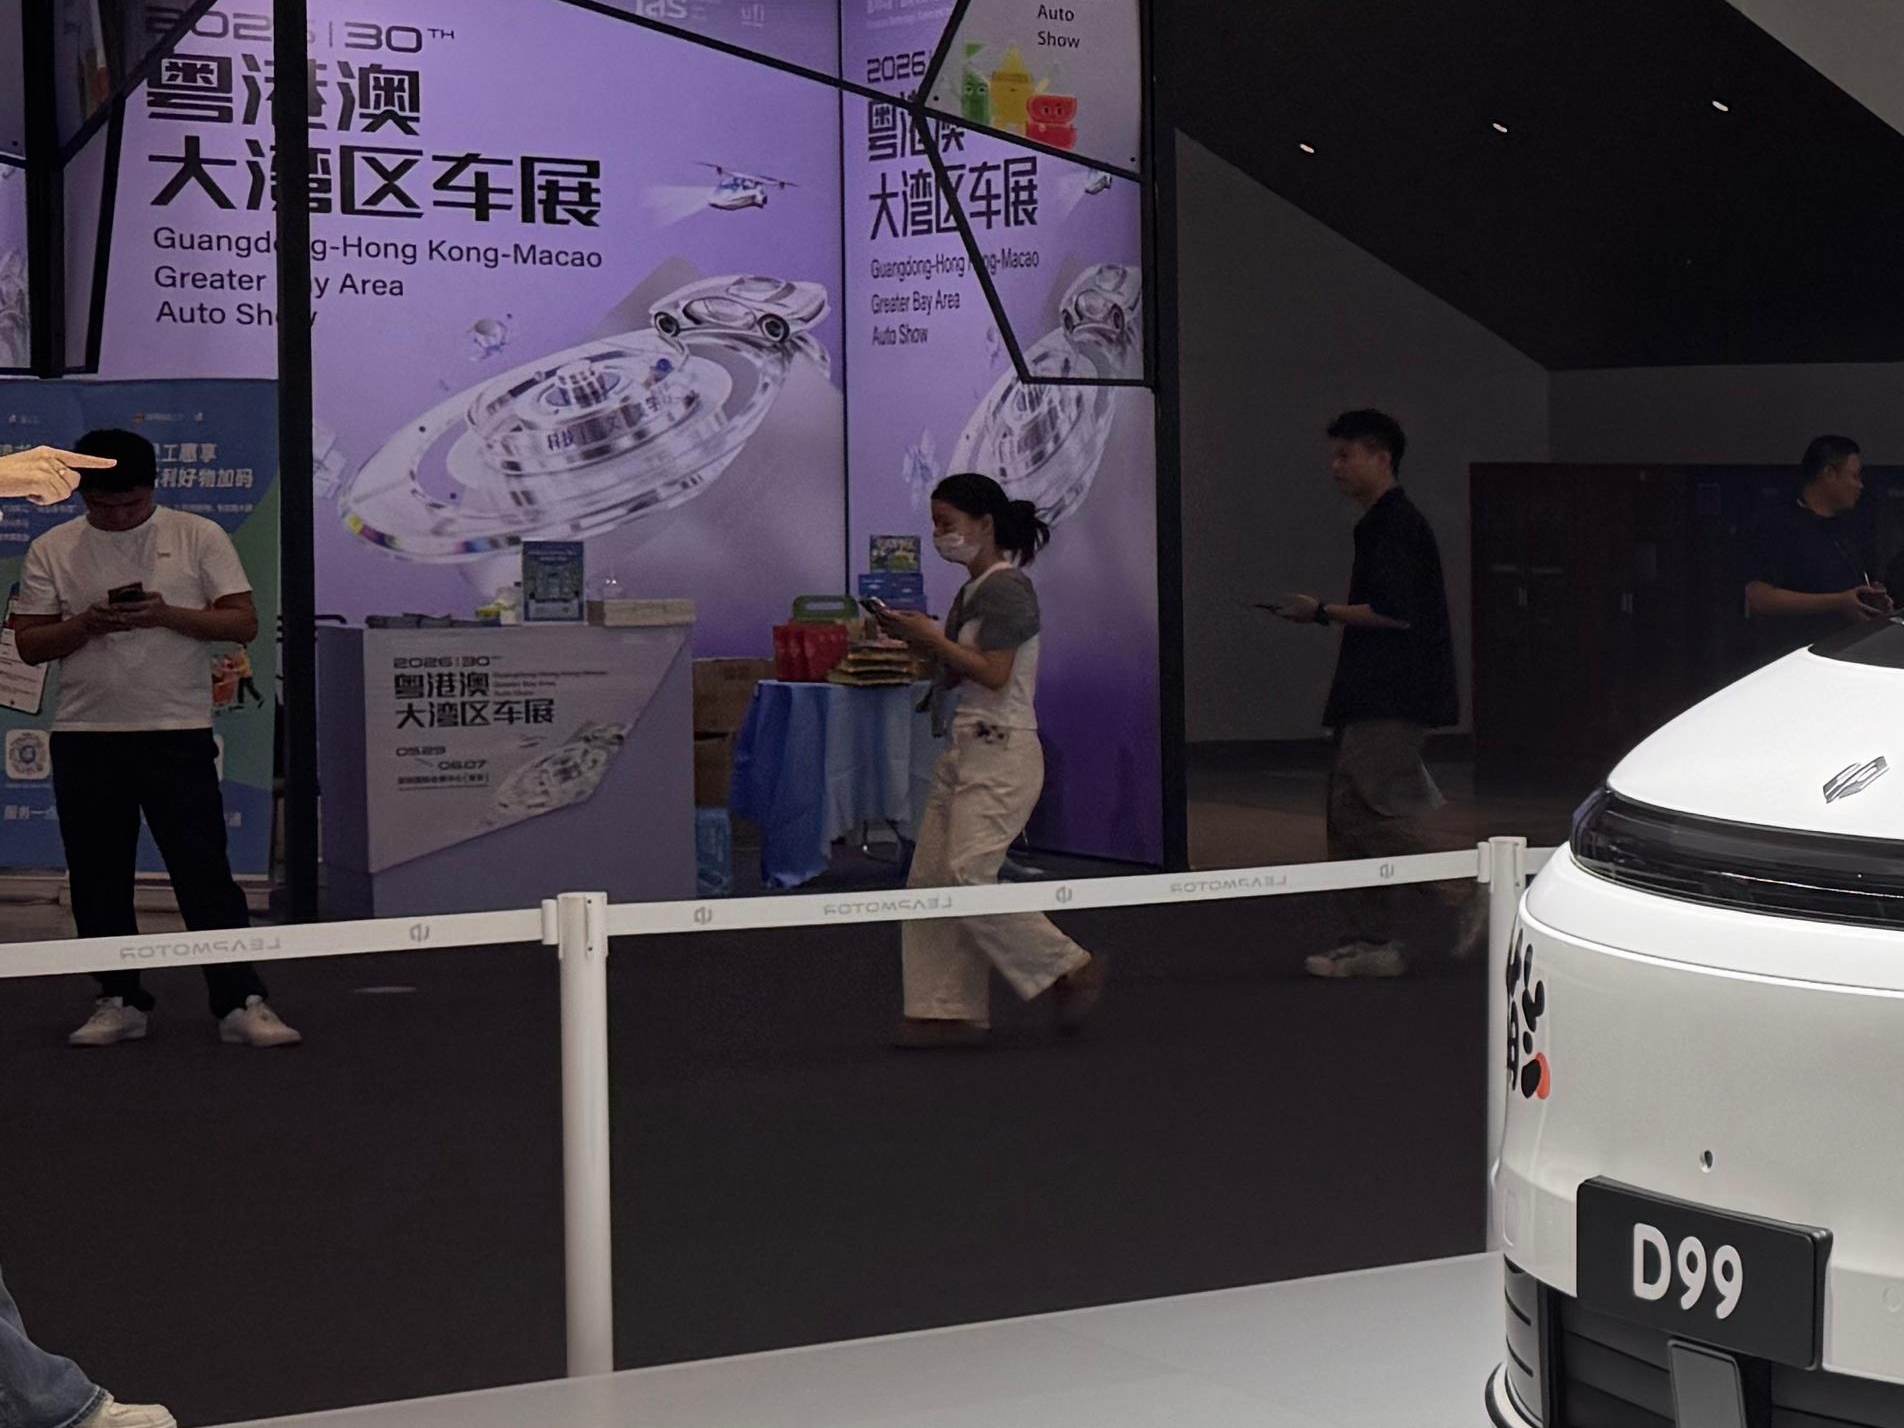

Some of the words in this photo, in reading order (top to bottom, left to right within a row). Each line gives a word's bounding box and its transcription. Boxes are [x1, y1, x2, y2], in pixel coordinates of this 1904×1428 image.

[147, 6, 316, 42] 202
[1037, 4, 1075, 22] Auto
[1037, 30, 1081, 49] Show
[867, 51, 926, 84] 2026
[148, 135, 601, 227] 大湾区车展
[869, 156, 1038, 240] 大湾区车展
[154, 228, 418, 265] Guangdg-Hong
[429, 240, 603, 269] Kong-Macao
[154, 266, 266, 292] Greater
[340, 273, 404, 296] Area
[155, 300, 226, 326] Auto
[872, 293, 911, 315] Greater
[913, 292, 933, 314] Bay
[935, 290, 961, 310] Area
[872, 325, 898, 346] Auto
[899, 323, 929, 345] Show
[155, 443, 218, 463] 工惠享
[154, 467, 254, 489] 利好物加码
[394, 672, 489, 699] 粤港澳
[396, 699, 555, 729] 大湾区车展
[1633, 1222, 1743, 1320] D99
